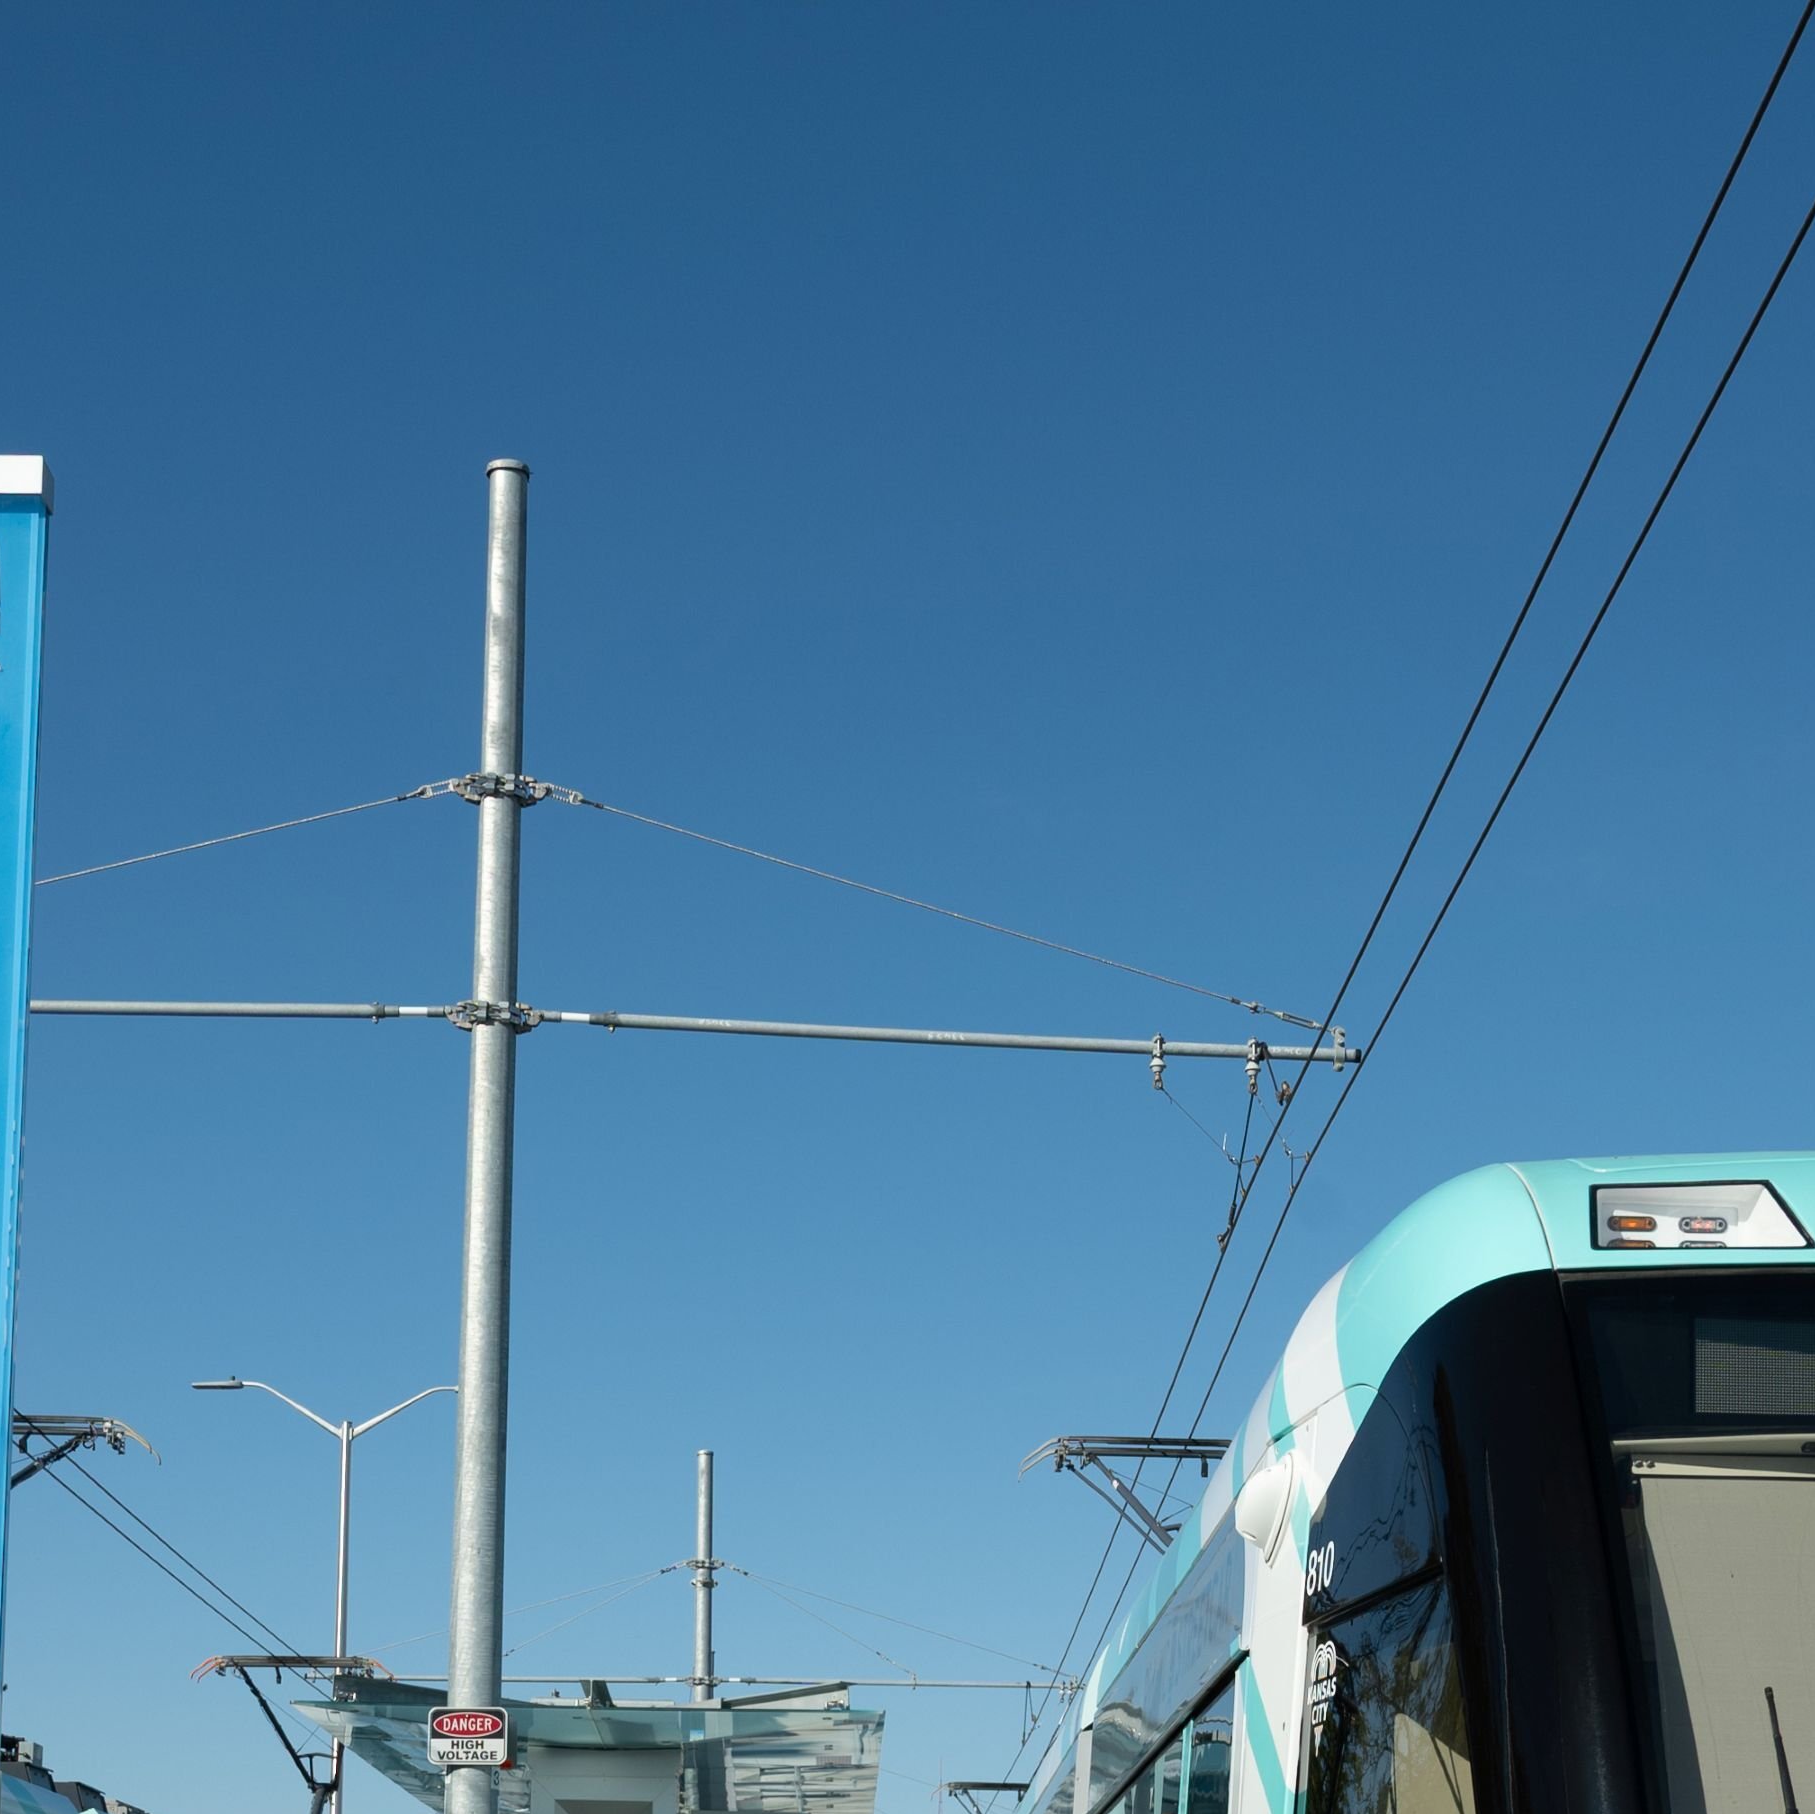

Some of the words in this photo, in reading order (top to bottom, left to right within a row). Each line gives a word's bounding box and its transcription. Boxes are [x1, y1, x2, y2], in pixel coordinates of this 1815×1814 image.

[1306, 1540, 1335, 1597] 810
[1307, 1677, 1337, 1705] KANSAS
[1311, 1701, 1329, 1725] CITY
[443, 1718, 492, 1731] DANGER
[451, 1740, 484, 1750] HIGH
[437, 1751, 498, 1760] VOLTAGE
